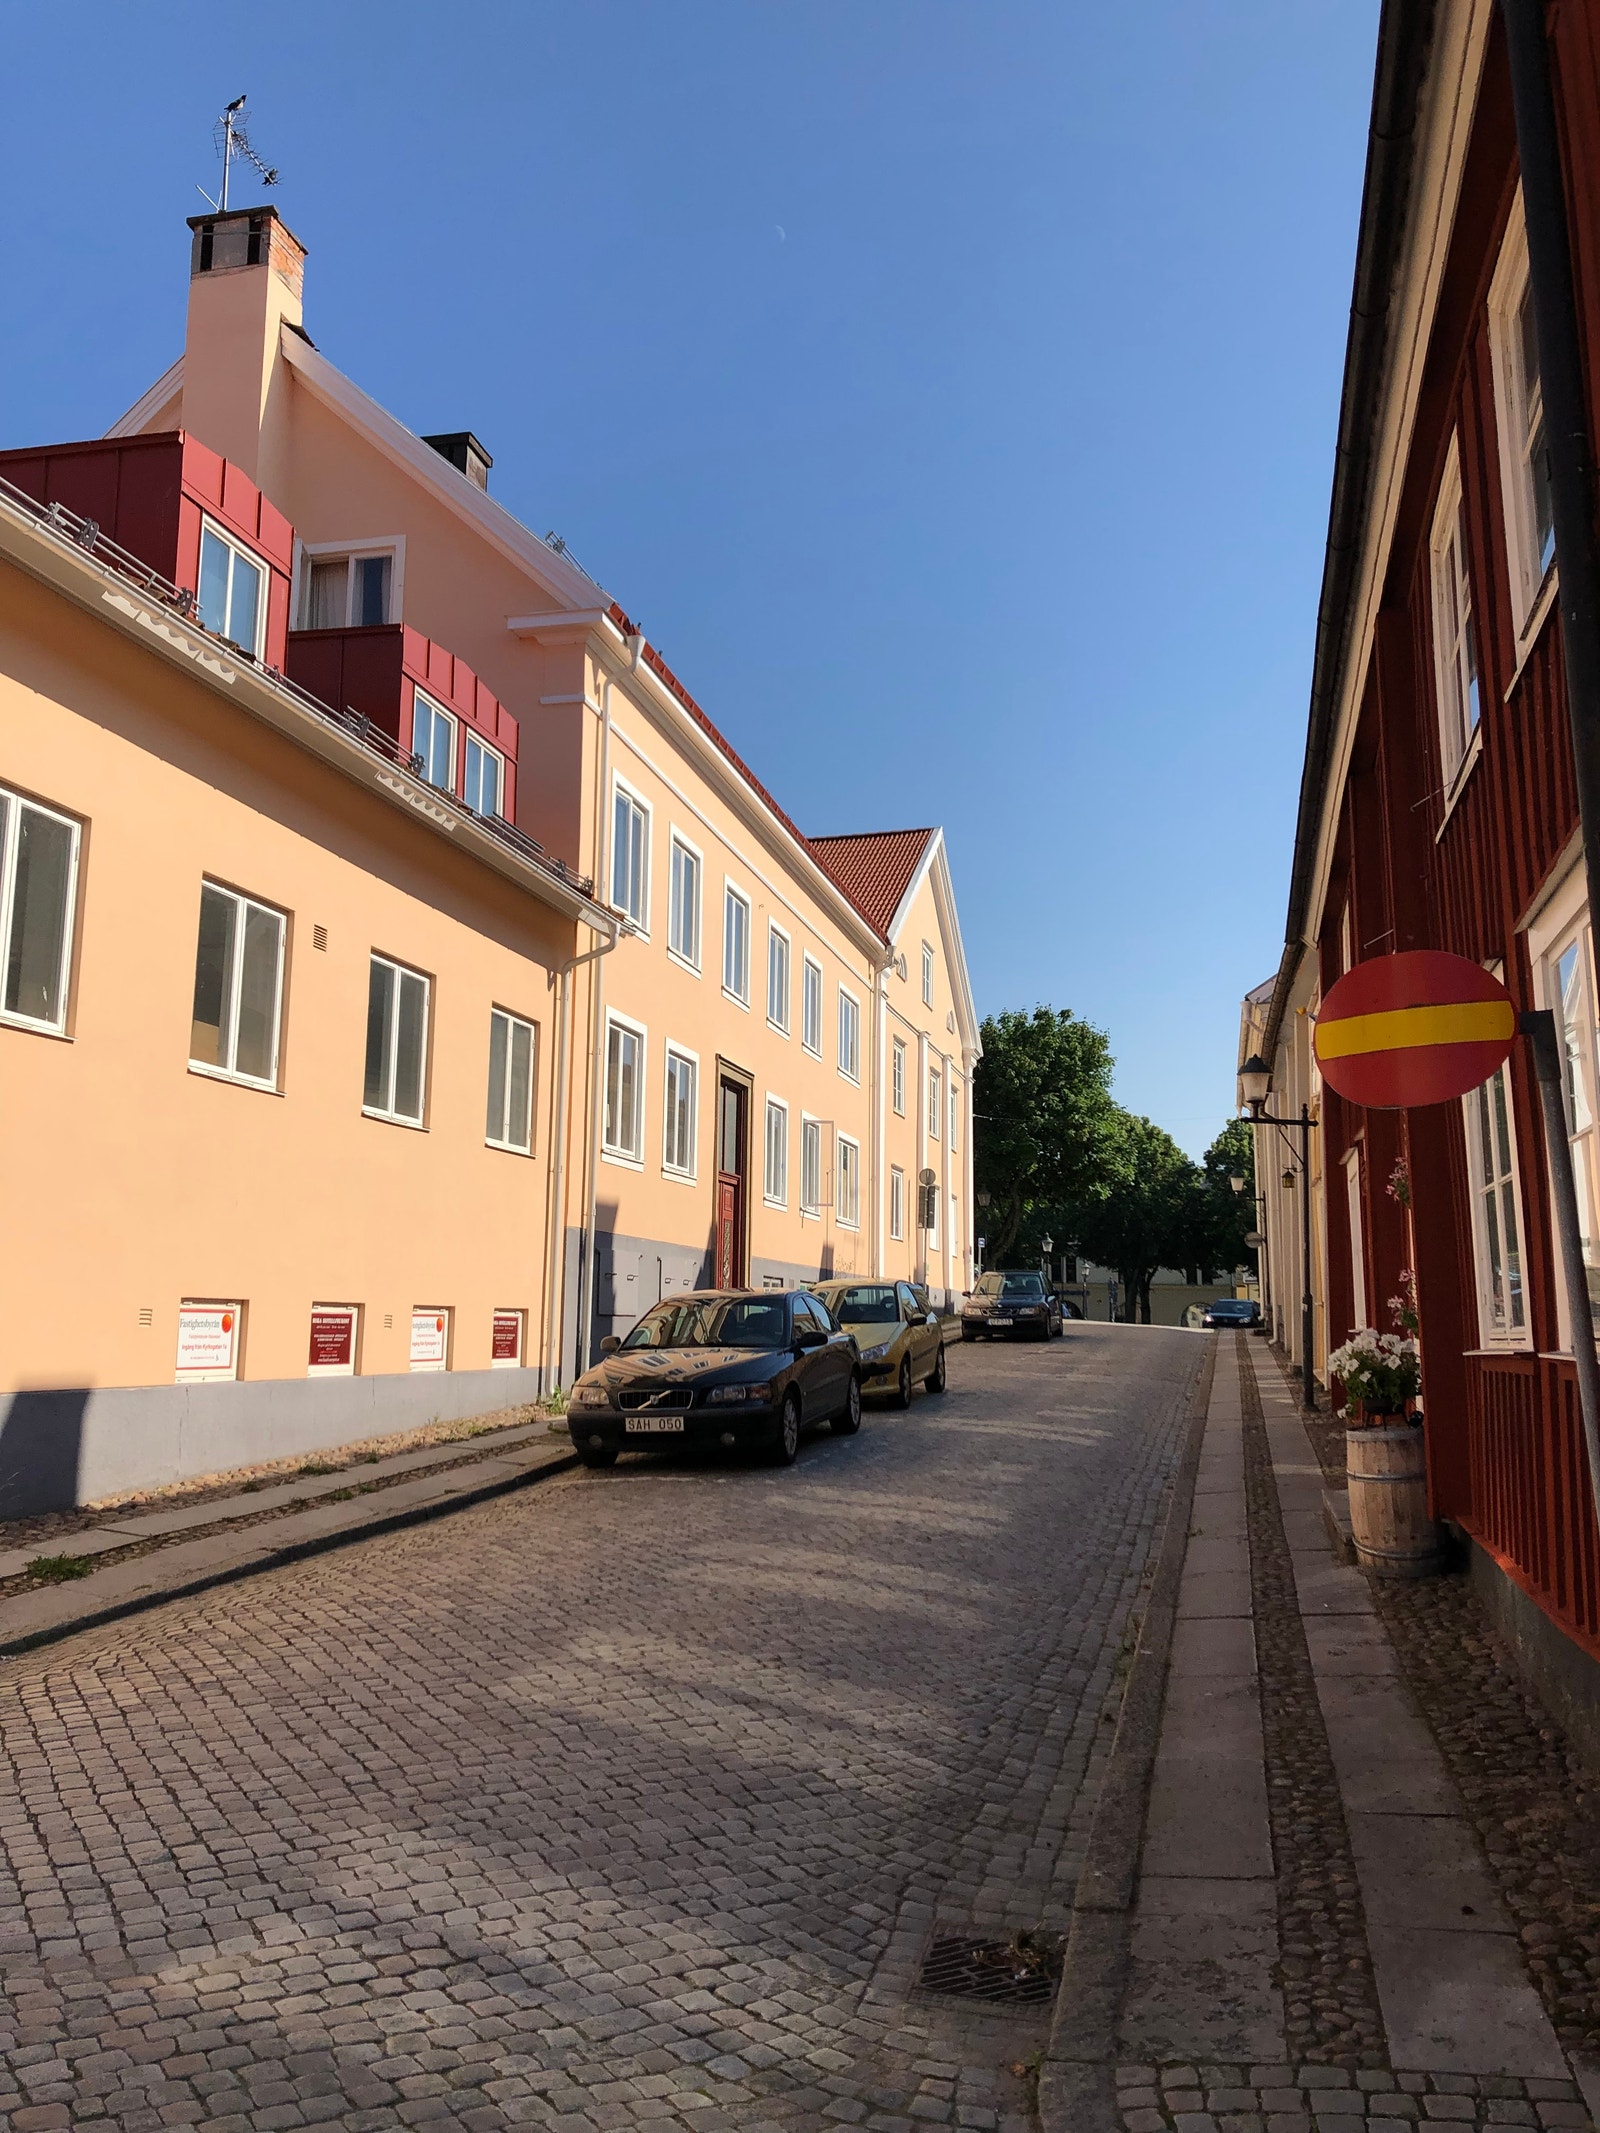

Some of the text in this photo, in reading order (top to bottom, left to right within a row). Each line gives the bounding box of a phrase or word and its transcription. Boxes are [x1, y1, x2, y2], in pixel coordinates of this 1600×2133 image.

[180, 1318, 220, 1330] Fastighetsbyrån
[628, 1418, 682, 1430] SAH 050
